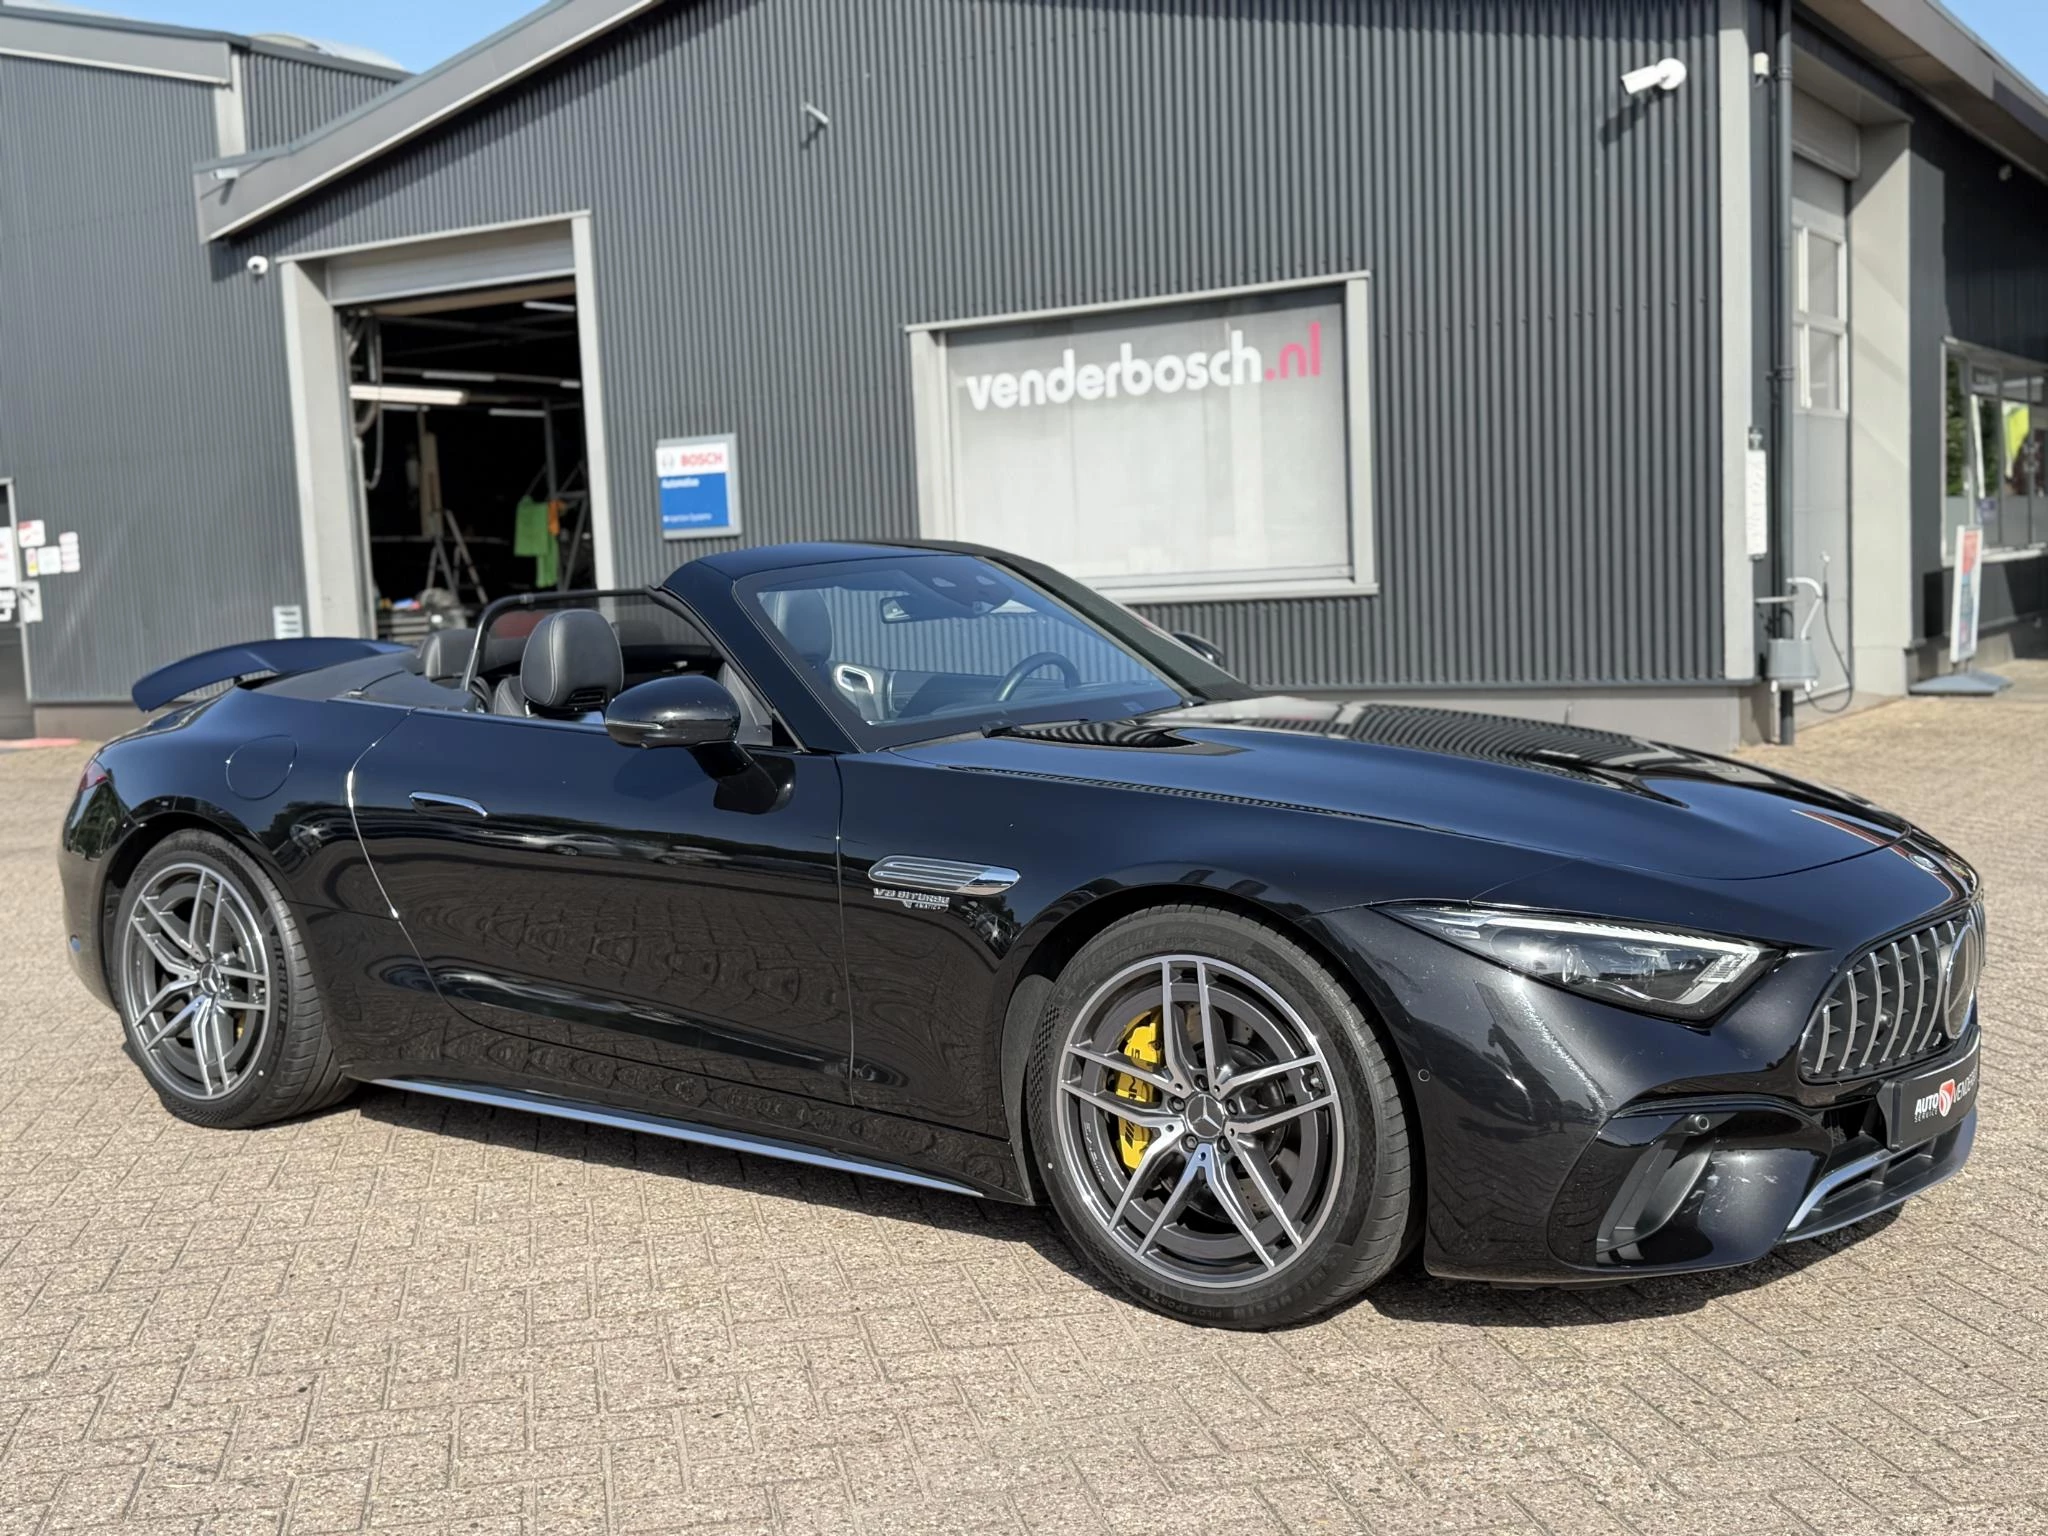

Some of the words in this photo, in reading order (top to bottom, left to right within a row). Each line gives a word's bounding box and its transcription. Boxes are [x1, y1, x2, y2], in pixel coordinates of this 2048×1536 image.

[965, 321, 1322, 411] venderbosch.nl
[680, 452, 723, 467] BOSCH
[897, 890, 951, 905] BITURBO
[1915, 1092, 1939, 1115] AUTO
